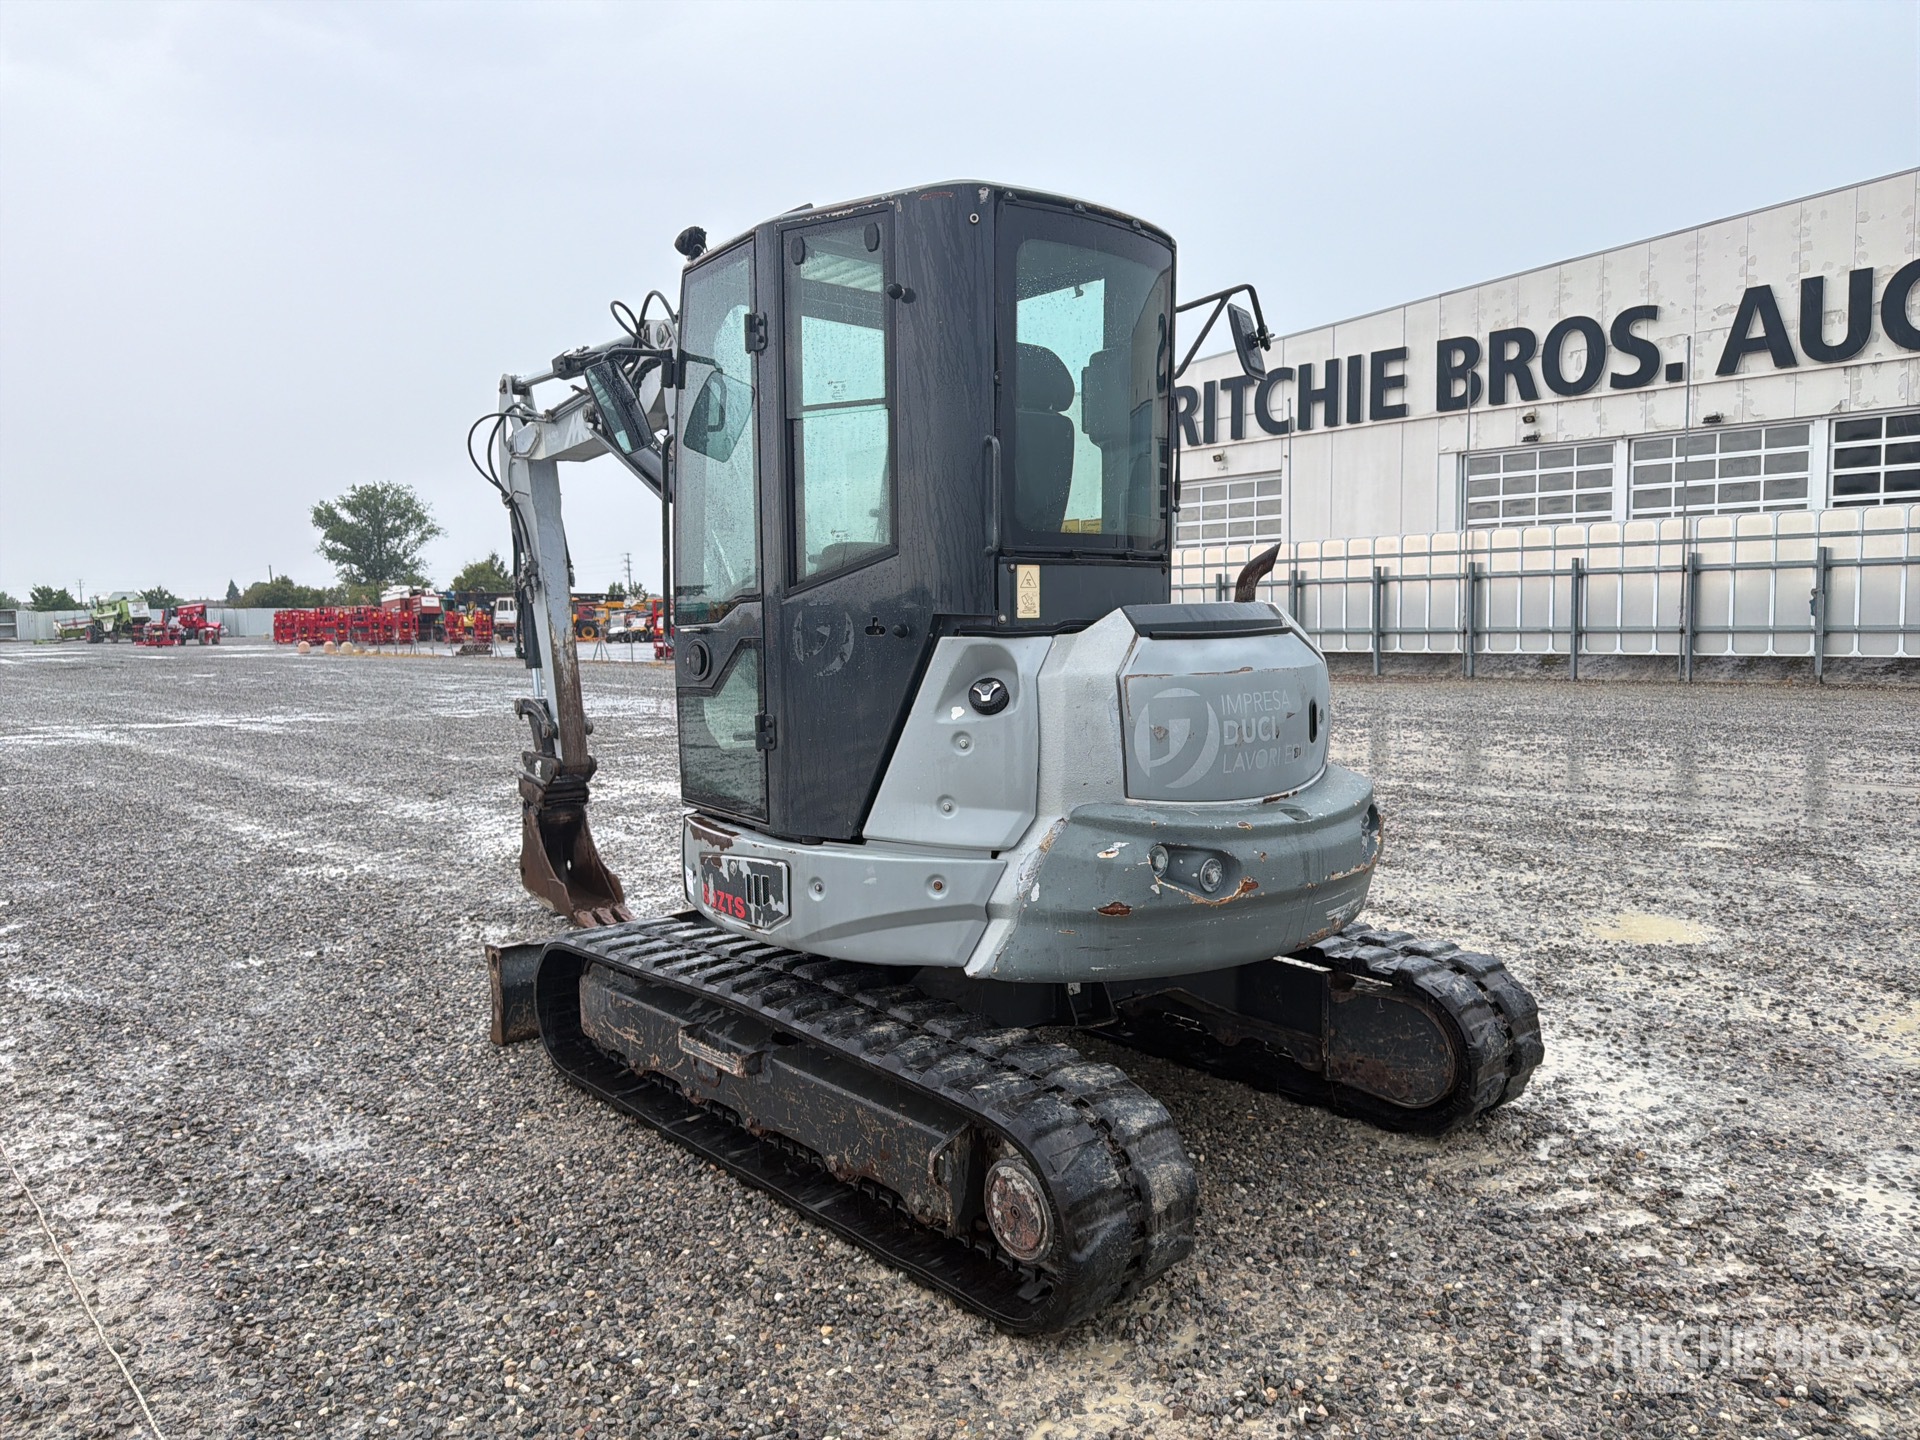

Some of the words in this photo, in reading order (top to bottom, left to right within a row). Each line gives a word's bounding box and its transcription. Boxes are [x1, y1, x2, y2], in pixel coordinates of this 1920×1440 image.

[1174, 346, 1409, 447] RITCHIE
[1436, 304, 1685, 412] BROS.
[1220, 689, 1290, 716] IMPRESA
[1223, 746, 1281, 774] LAVORI
